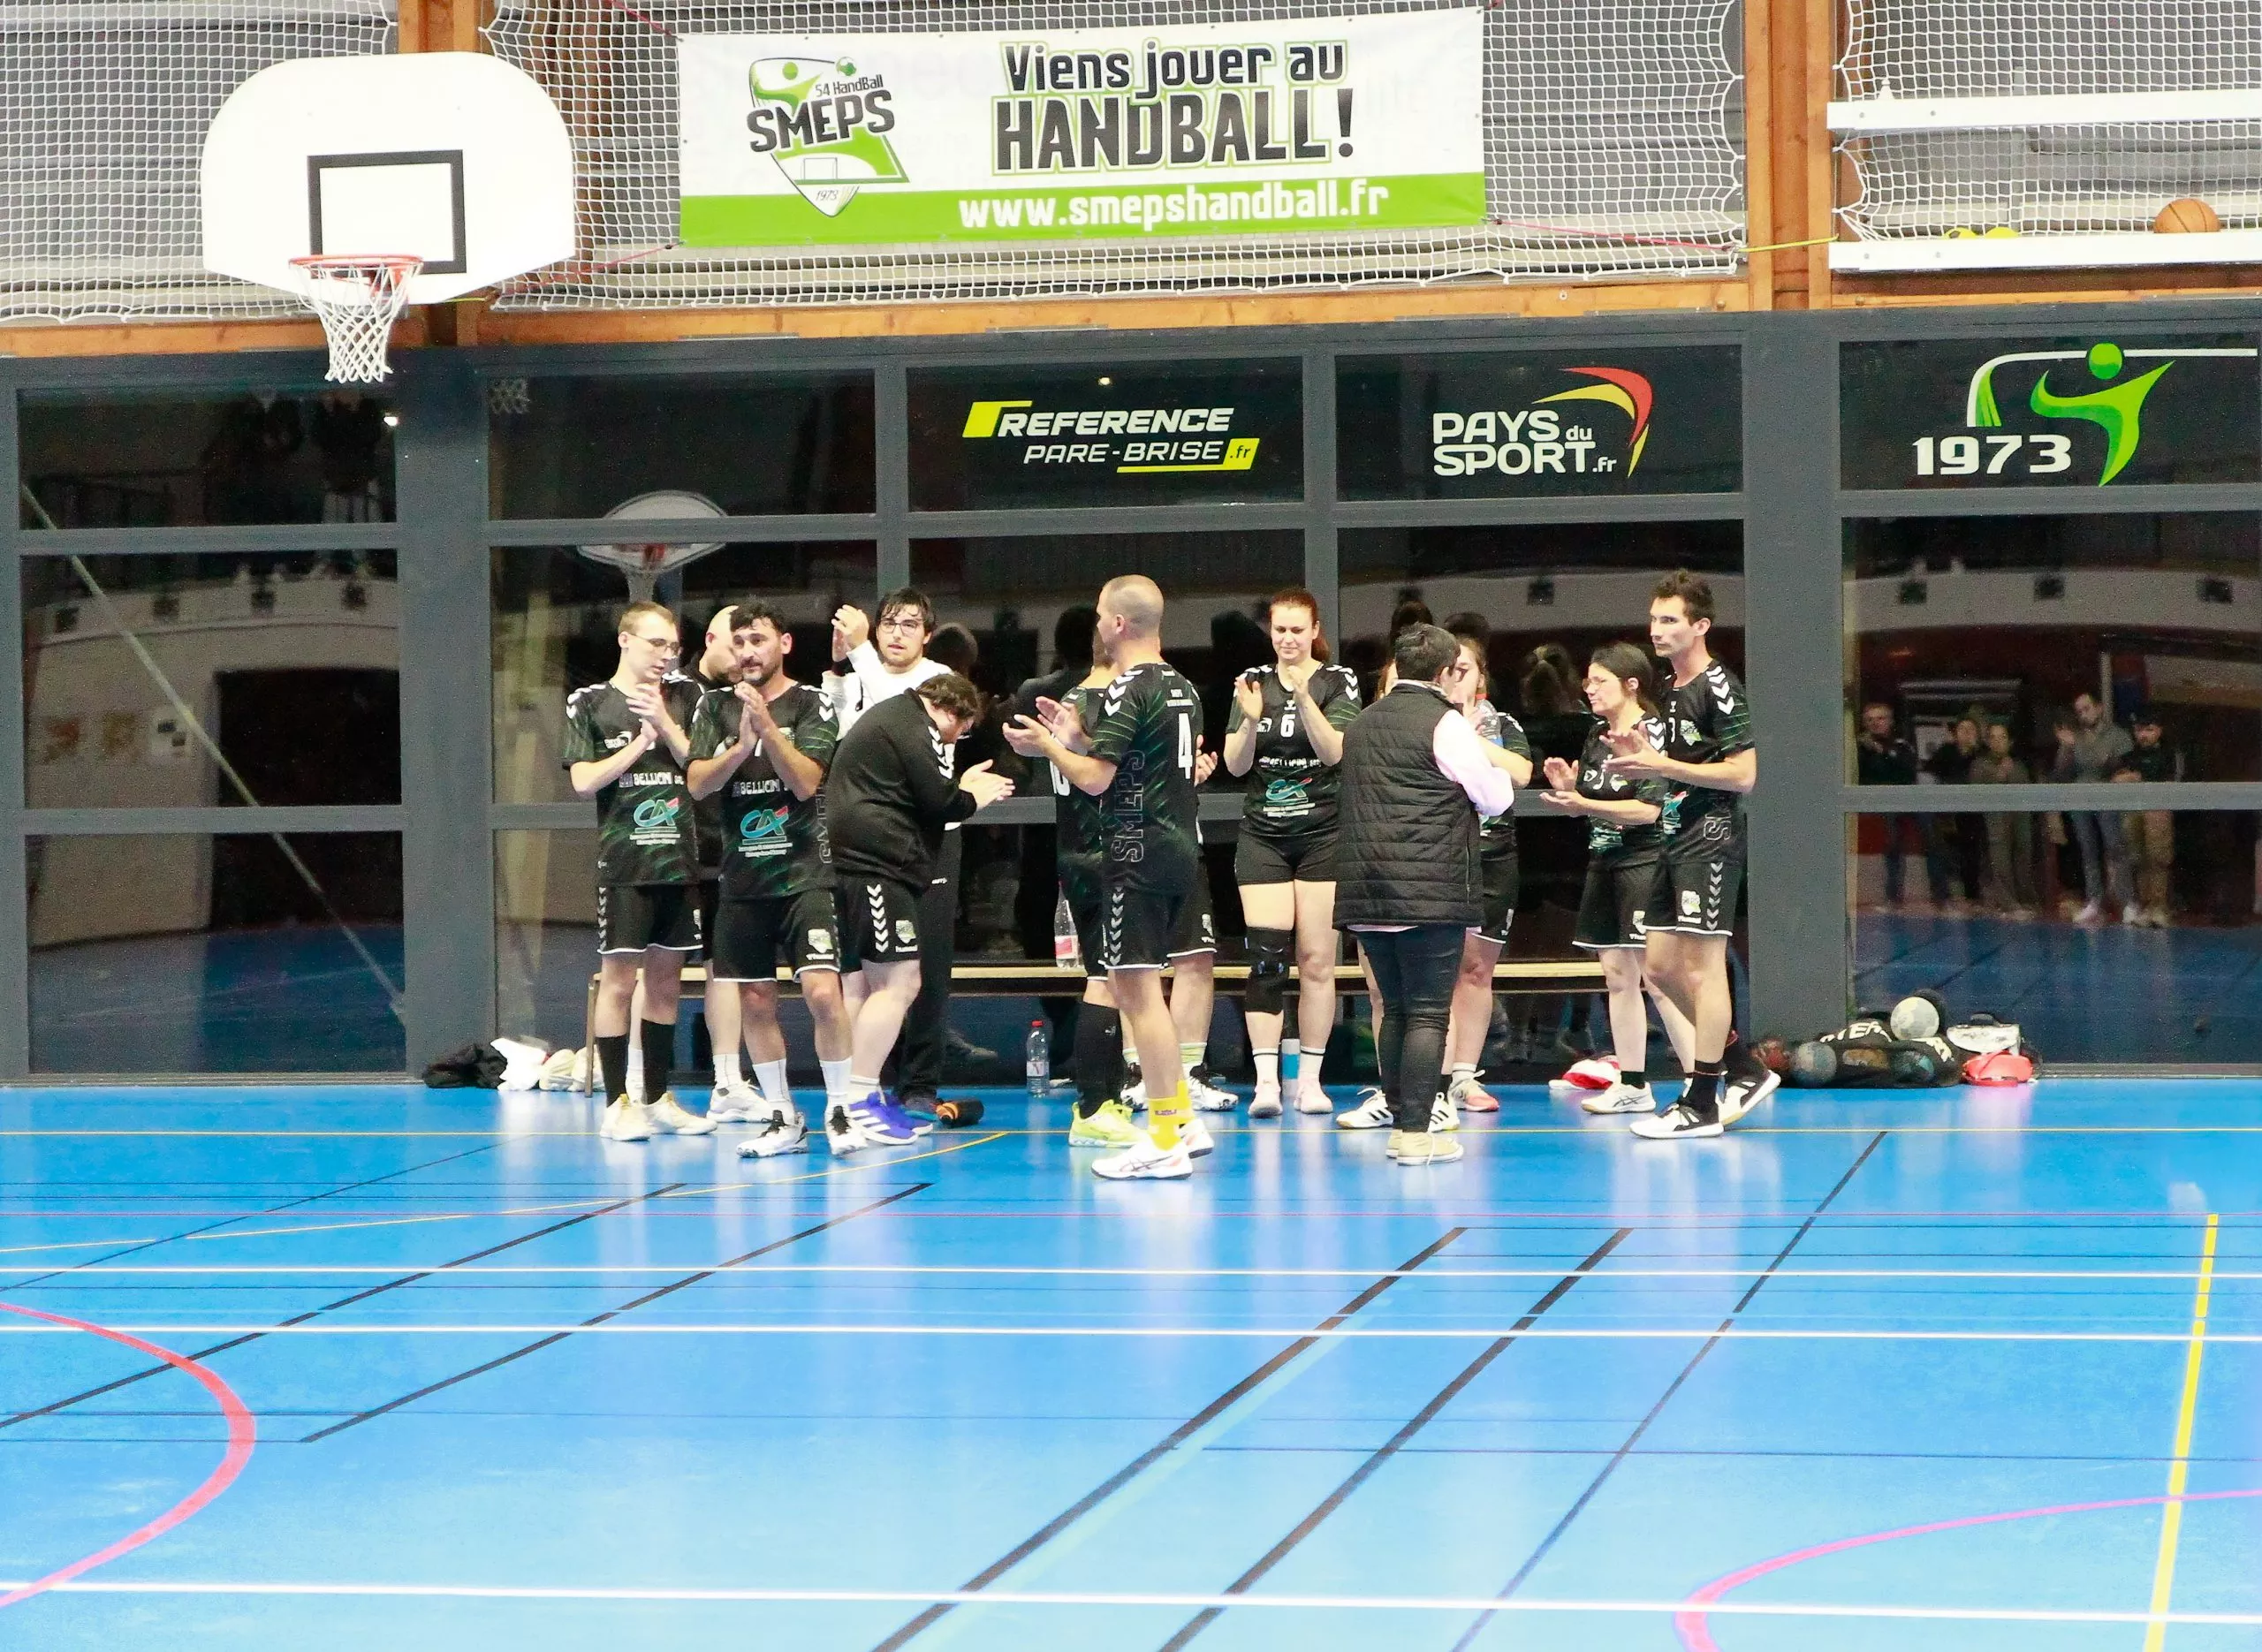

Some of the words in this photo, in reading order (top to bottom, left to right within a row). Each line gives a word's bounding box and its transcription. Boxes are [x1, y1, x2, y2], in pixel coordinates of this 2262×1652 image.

[816, 83, 831, 96] 54
[833, 74, 884, 95] HandBall
[1006, 44, 1129, 91] Viens
[1135, 41, 1272, 99] jouer
[1289, 44, 1344, 80] au
[747, 89, 895, 153] SMEPS
[816, 189, 839, 201] 1973
[959, 179, 1389, 231] www.smepshandball.fr
[998, 407, 1234, 437] REFERENCE
[1433, 410, 1560, 443] PAYS
[1565, 425, 1592, 441] du
[1912, 434, 2071, 475] 1973
[1280, 713, 1295, 738] 6
[1178, 712, 1193, 779] 4
